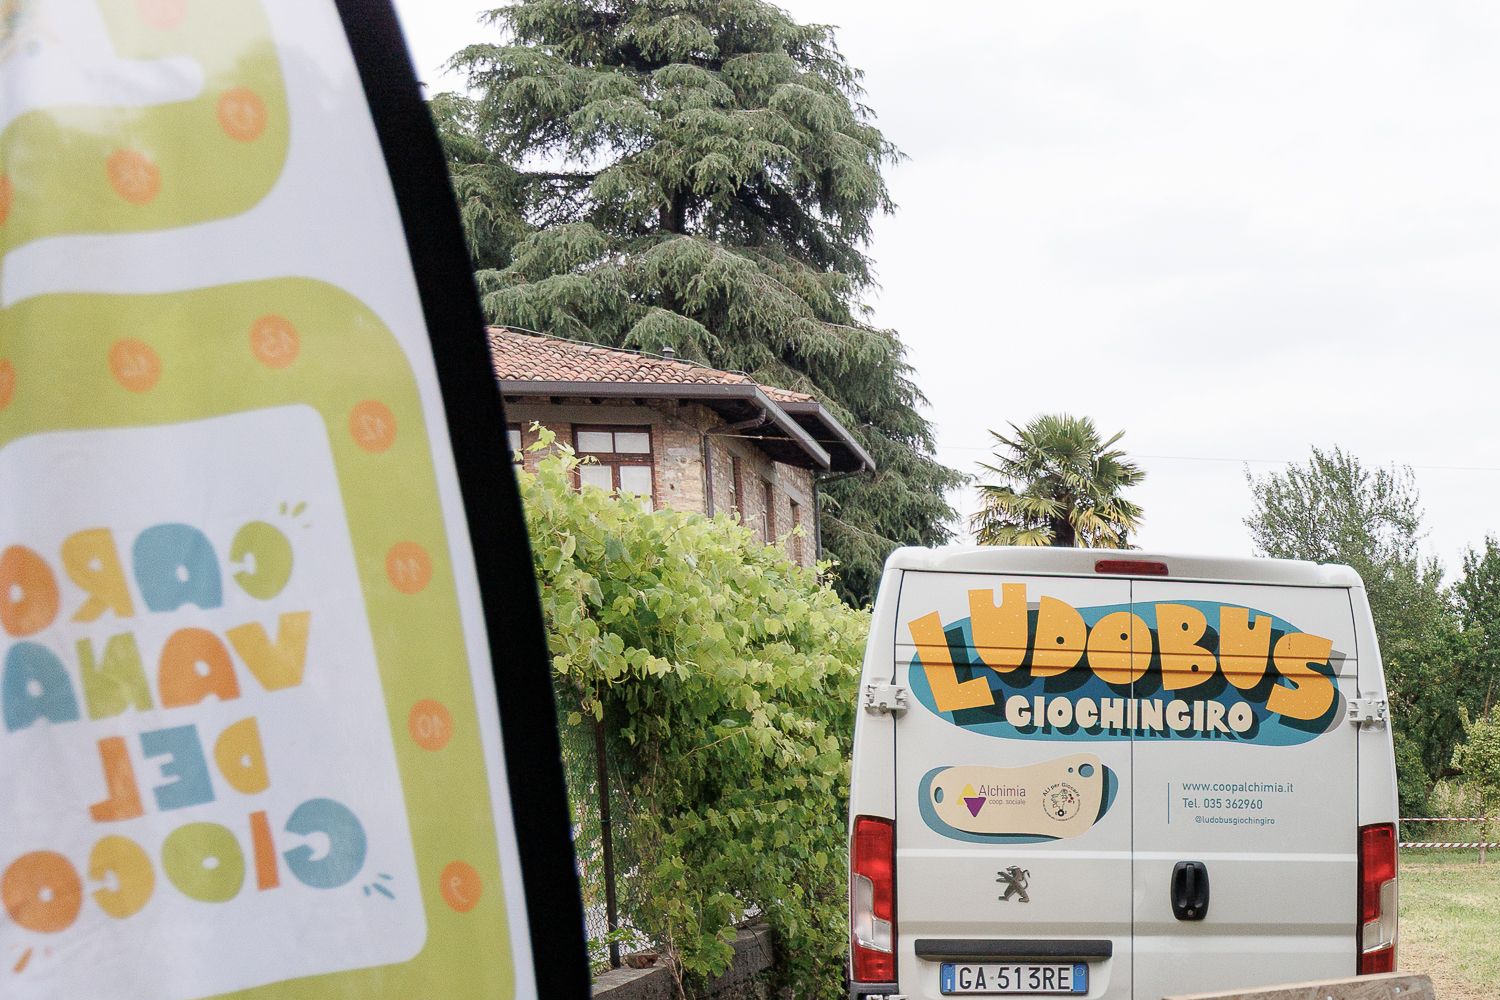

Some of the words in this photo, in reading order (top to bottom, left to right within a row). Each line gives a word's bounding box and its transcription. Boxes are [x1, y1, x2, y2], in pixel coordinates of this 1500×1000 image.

[908, 583, 1336, 720] LUDOBUS
[1005, 695, 1252, 733] GIOCHINGIRO
[978, 784, 1026, 797] Alchimia
[1182, 782, 1294, 794] www.coopalchimia.it
[1182, 797, 1200, 809] Tel.
[1203, 798, 1222, 809] 035
[1225, 798, 1263, 810] 362960
[1195, 815, 1275, 826] @ludobusgiochingiro
[959, 966, 987, 990] GA
[997, 966, 1071, 990] 513RE
